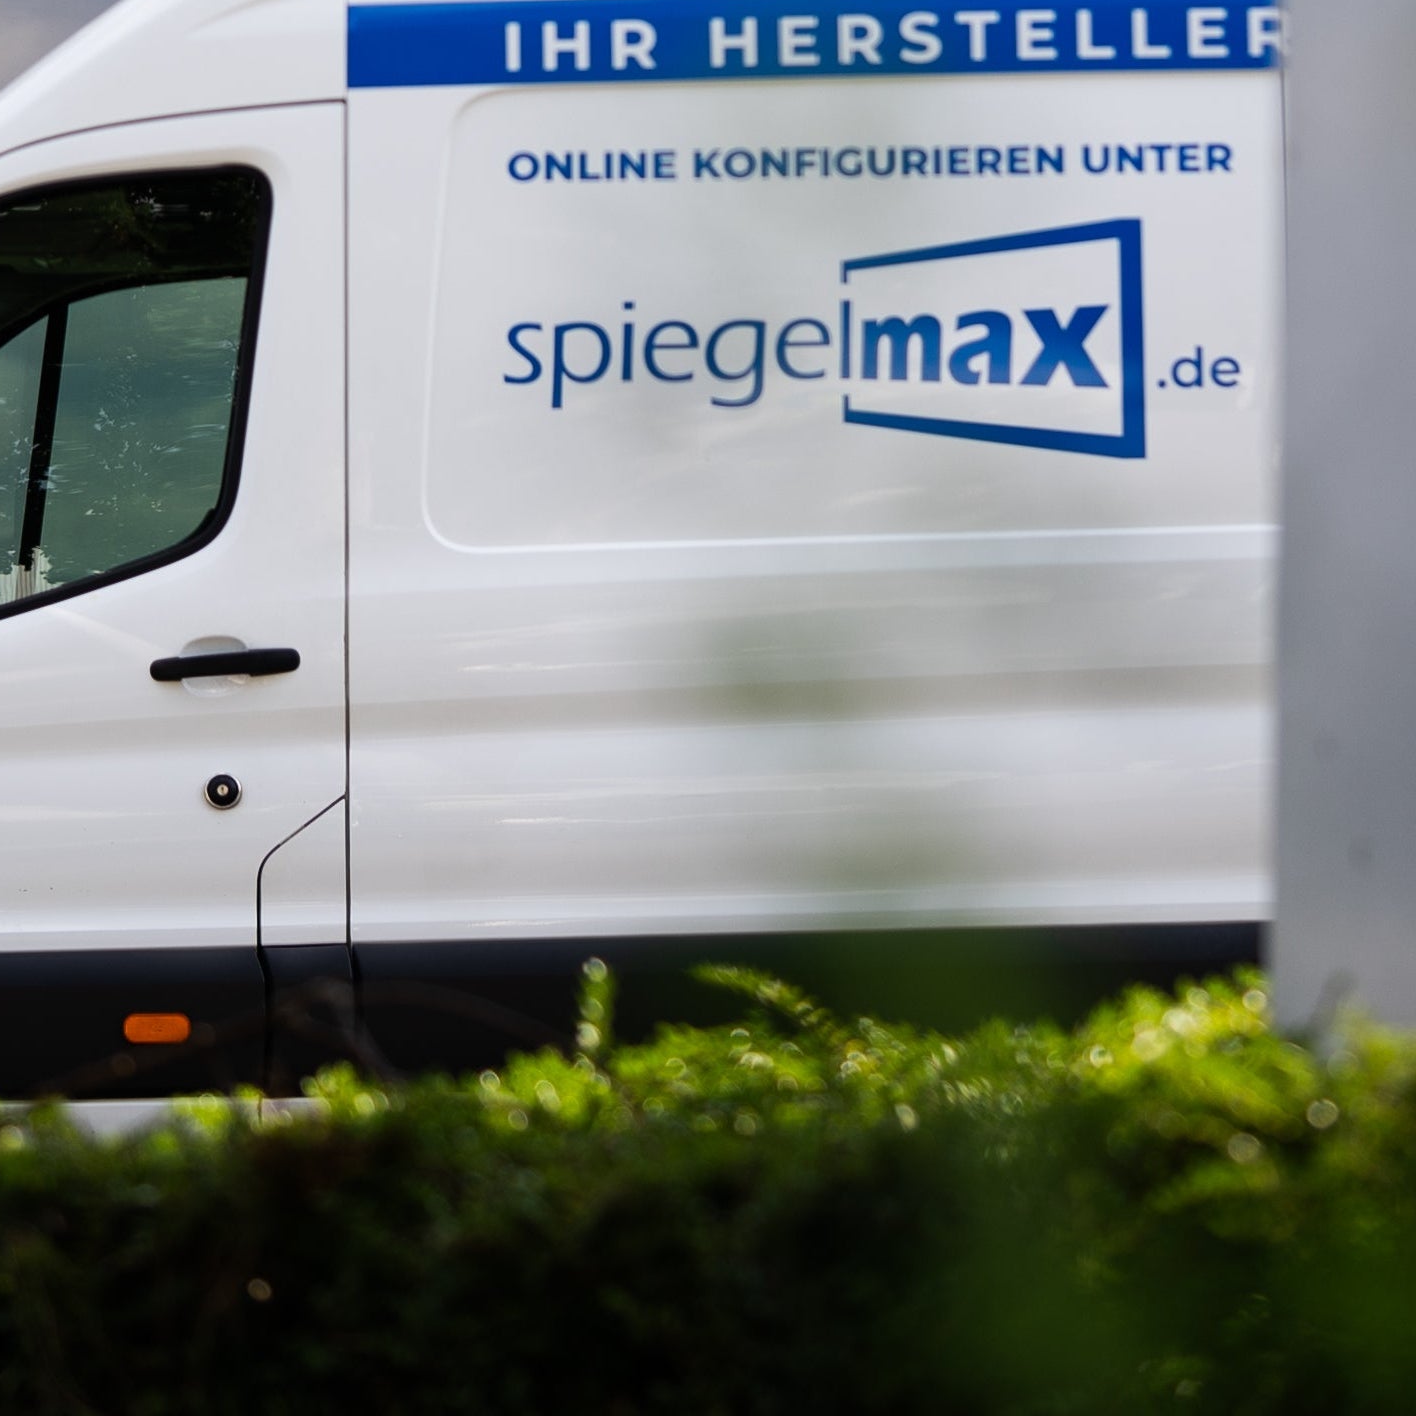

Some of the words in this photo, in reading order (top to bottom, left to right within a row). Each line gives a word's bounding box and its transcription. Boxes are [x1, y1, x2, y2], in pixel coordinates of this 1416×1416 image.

[503, 18, 658, 72] IHR
[707, 5, 1289, 70] HERSTELLER
[507, 150, 678, 182] ONLINE
[692, 144, 1065, 180] KONFIGURIEREN
[1082, 142, 1234, 176] UNTER
